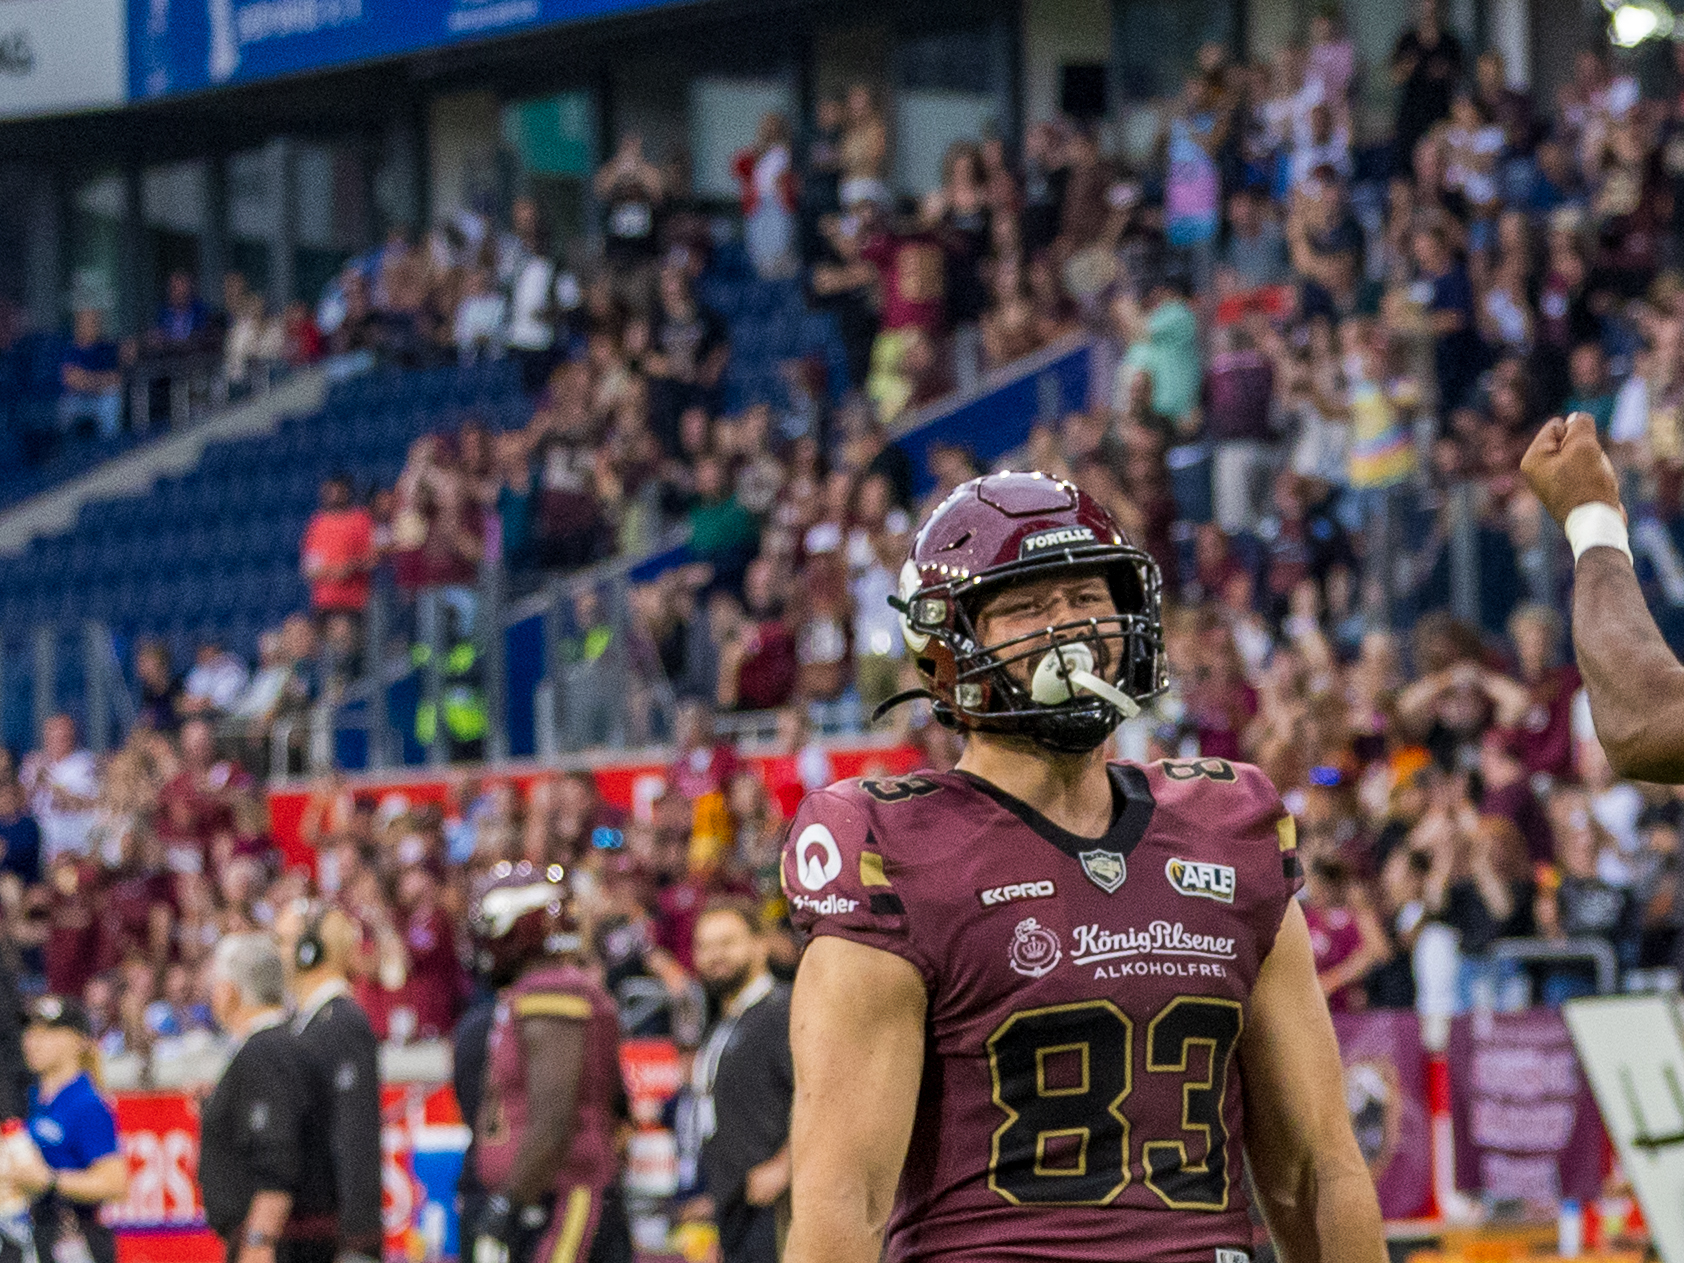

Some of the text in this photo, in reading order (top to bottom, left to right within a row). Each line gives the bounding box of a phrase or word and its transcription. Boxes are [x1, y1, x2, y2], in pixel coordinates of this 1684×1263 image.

[1025, 528, 1095, 552] FORELLE
[1182, 864, 1232, 894] AFLE
[1070, 923, 1151, 957] König
[1149, 920, 1236, 954] Pilsener
[1094, 961, 1227, 979] ALKOHOLFREI
[986, 996, 1244, 1211] 83
